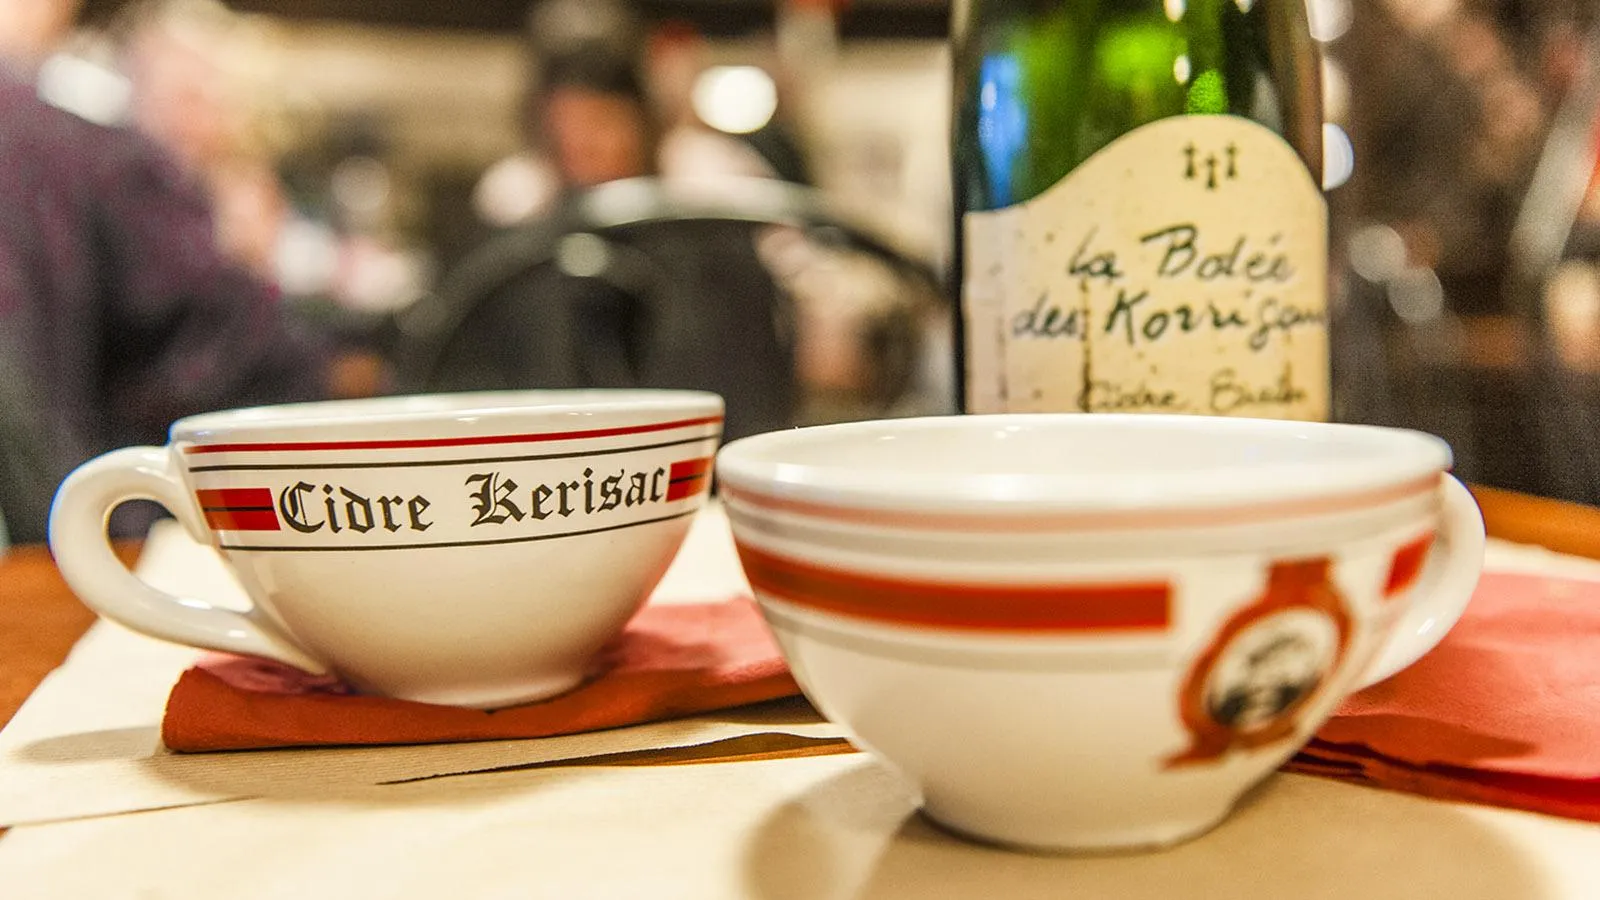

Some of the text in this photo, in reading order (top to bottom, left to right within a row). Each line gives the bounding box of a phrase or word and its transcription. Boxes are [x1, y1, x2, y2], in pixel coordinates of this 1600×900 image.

[1068, 226, 1122, 279] La
[1012, 291, 1079, 338] des
[279, 466, 665, 534] Cidre Kerisac
